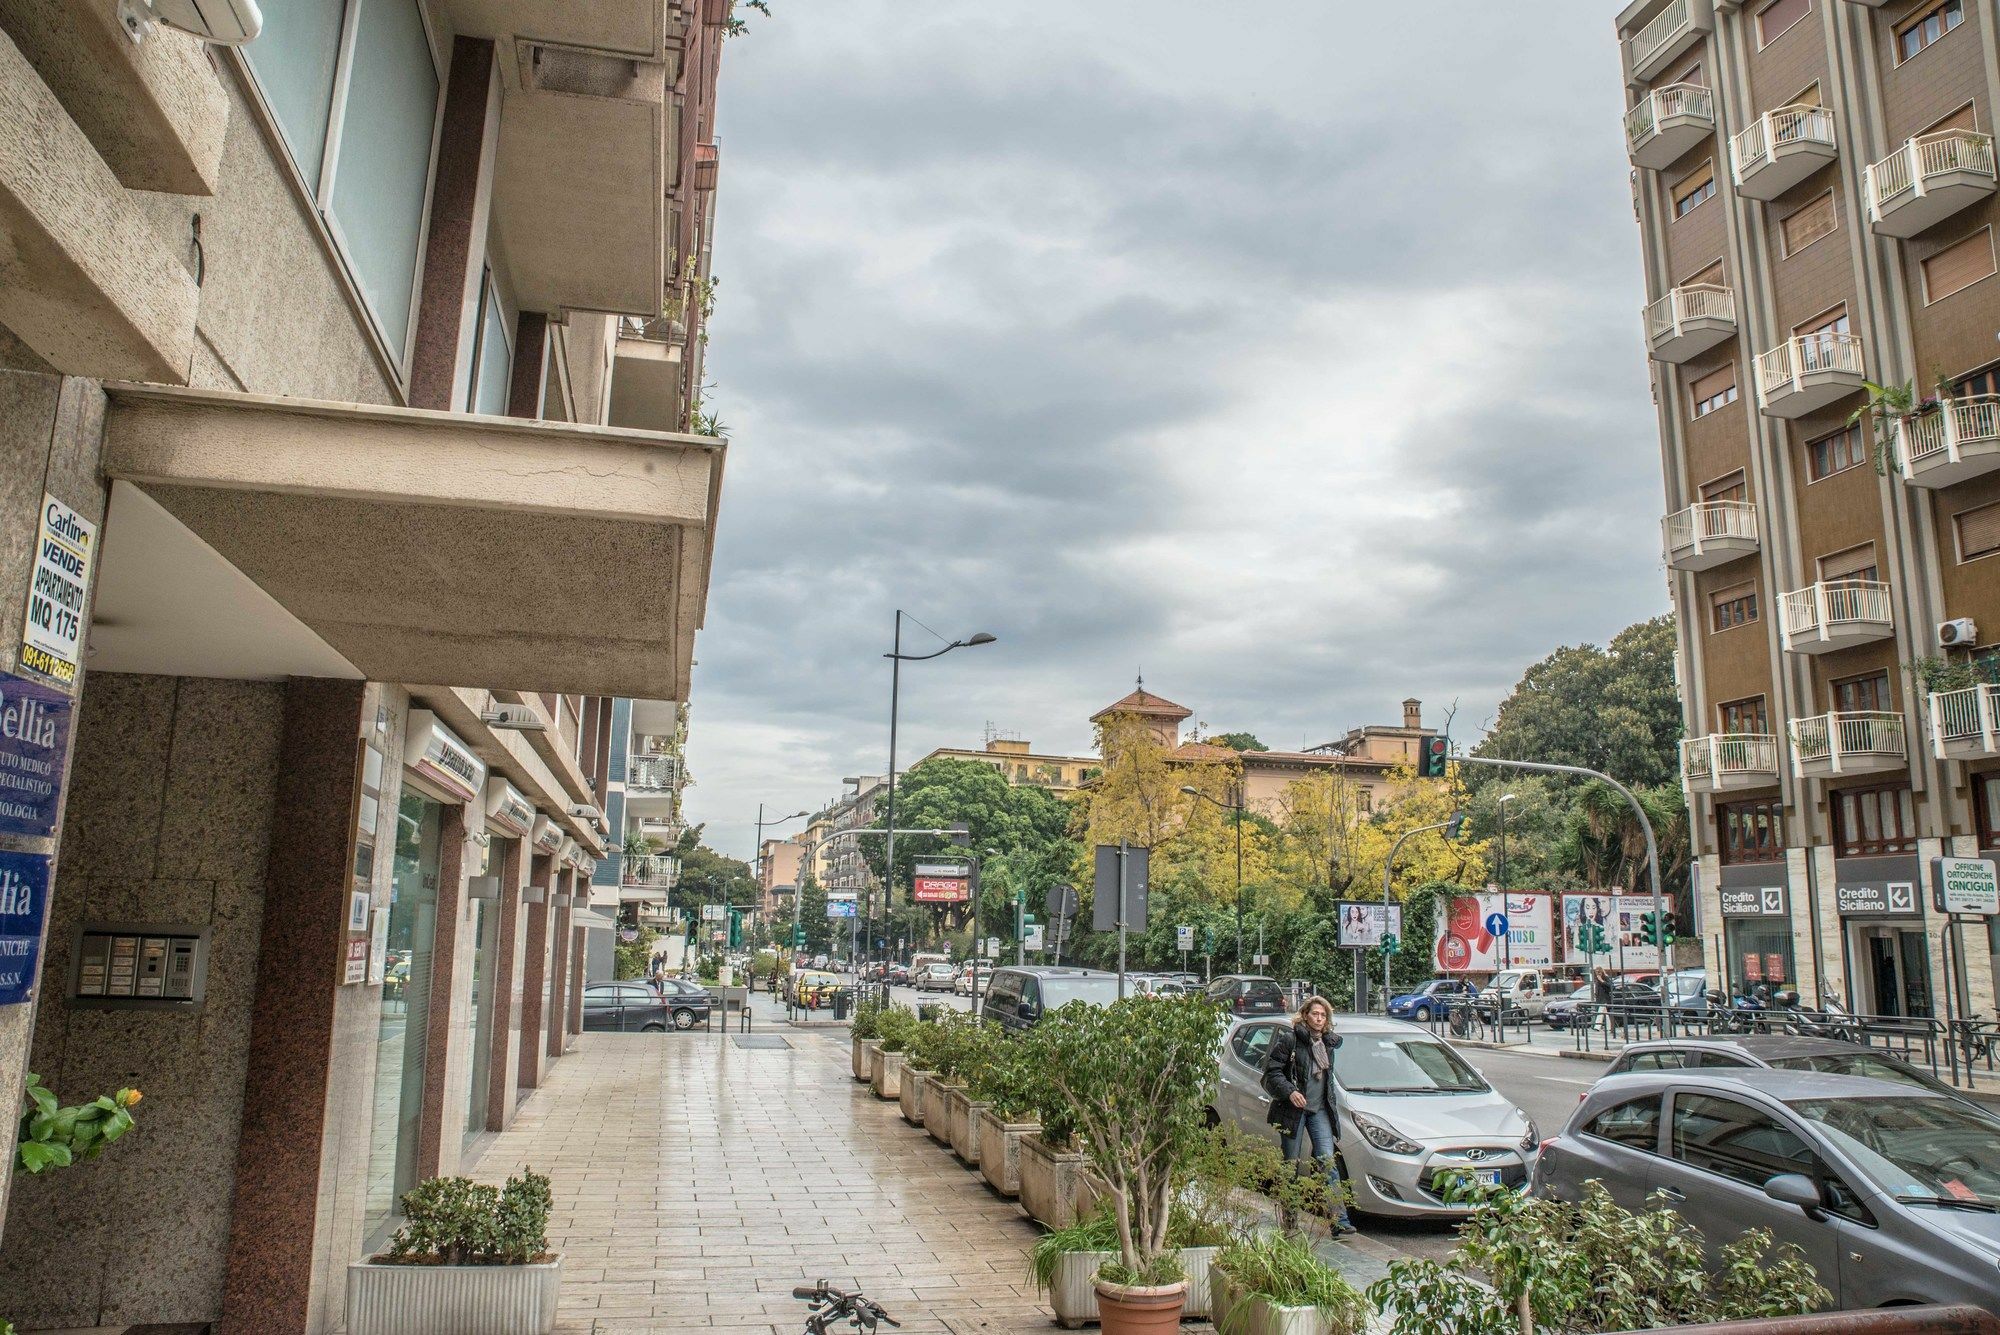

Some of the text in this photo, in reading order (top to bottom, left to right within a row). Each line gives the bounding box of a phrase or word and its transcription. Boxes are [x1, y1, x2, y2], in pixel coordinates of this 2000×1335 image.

[47, 503, 88, 547] Carlino
[43, 538, 85, 579] VENDE
[34, 565, 83, 613] APPARTAMENTO
[30, 594, 79, 642] MQ 175
[22, 645, 75, 682] 091-6112668
[0, 751, 51, 776] UTO MEDICO
[1954, 863, 1984, 871] OFFICINE
[1946, 870, 1993, 880] ORTOPEDICHE
[923, 881, 957, 889] DRAGO
[1947, 880, 1995, 892] CANCIGLIA
[1722, 892, 1755, 903] Credito
[1838, 888, 1879, 899] Credito
[1722, 903, 1760, 913] Siciliano
[1839, 899, 1885, 911] Siciliano
